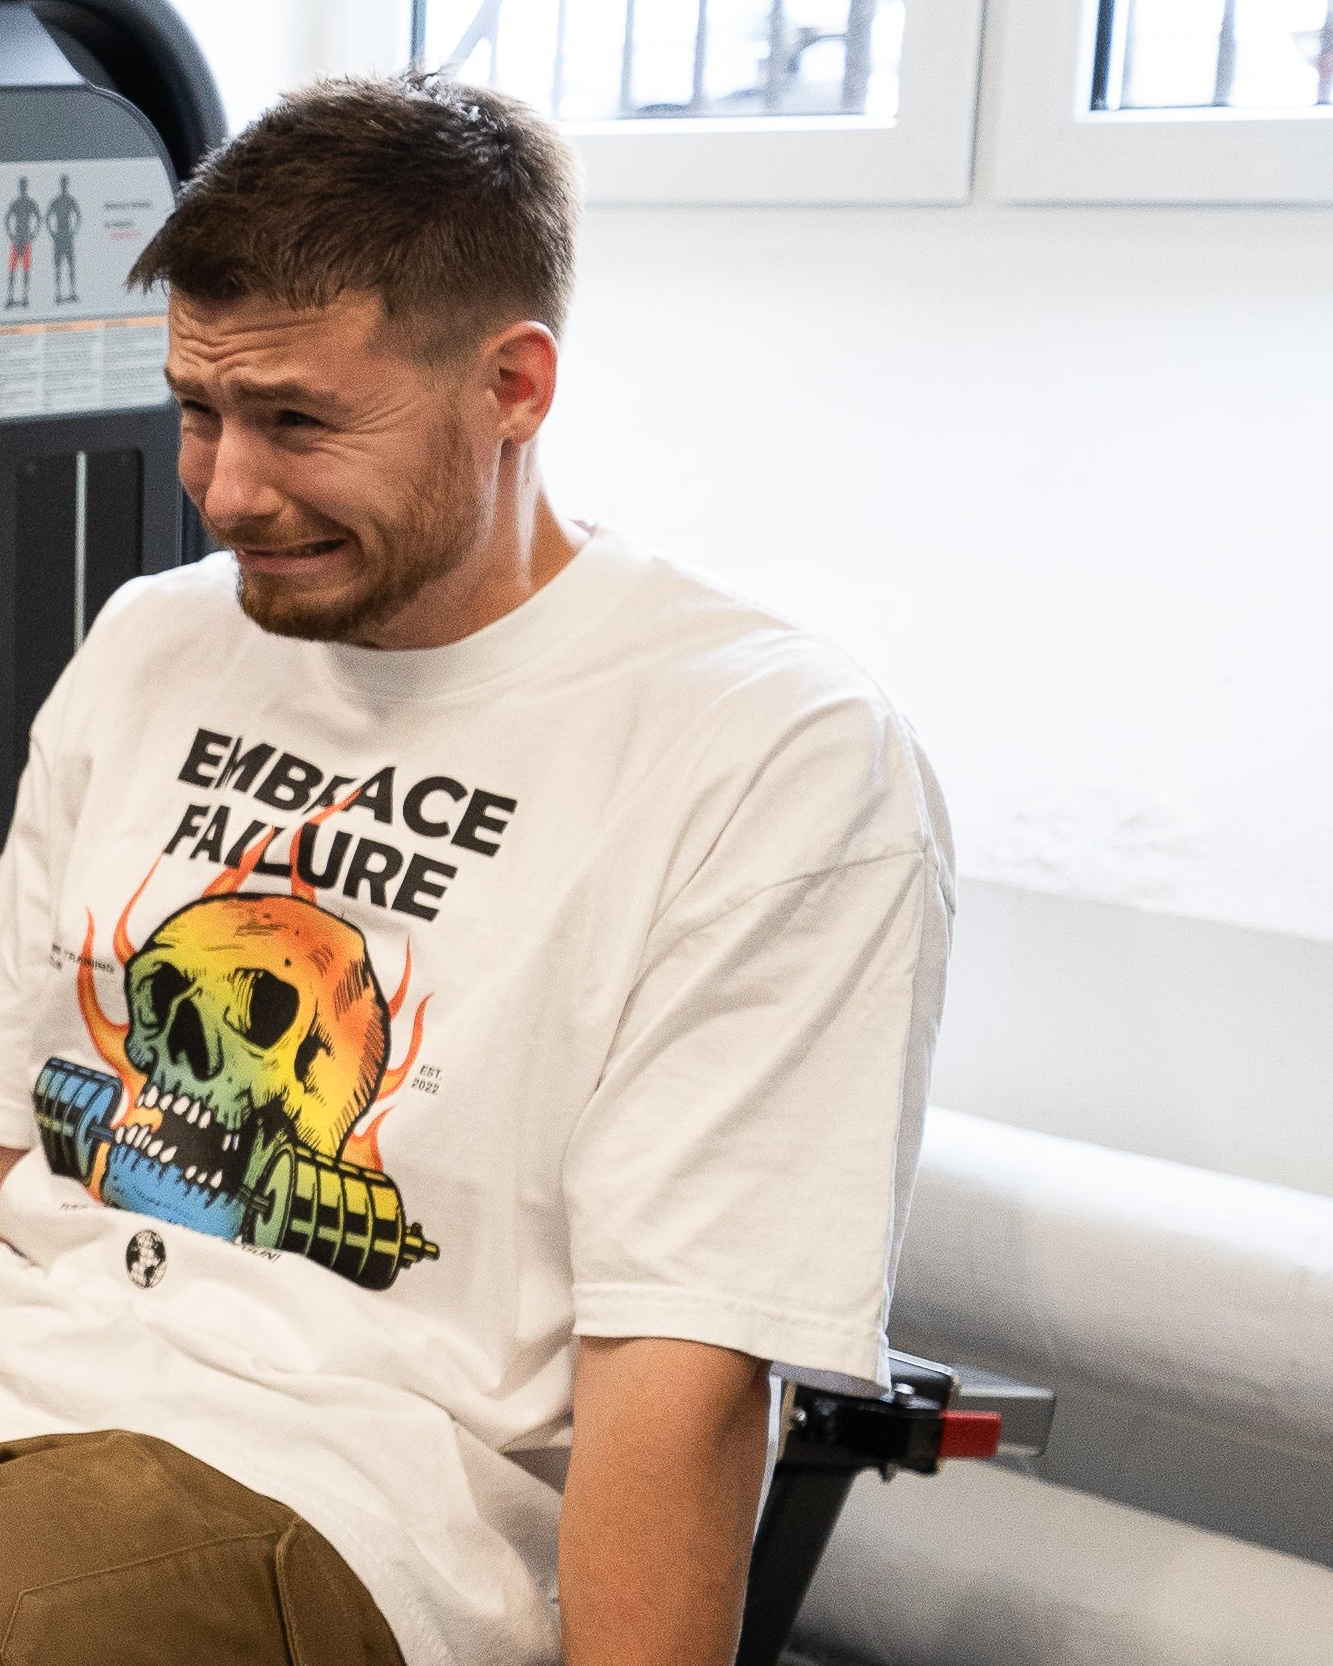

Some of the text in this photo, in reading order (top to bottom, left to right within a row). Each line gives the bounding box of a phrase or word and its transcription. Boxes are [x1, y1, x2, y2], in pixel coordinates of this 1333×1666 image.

[177, 727, 518, 859] EMBRACE
[164, 804, 459, 923] FAILURE
[411, 1078, 440, 1095] 2022
